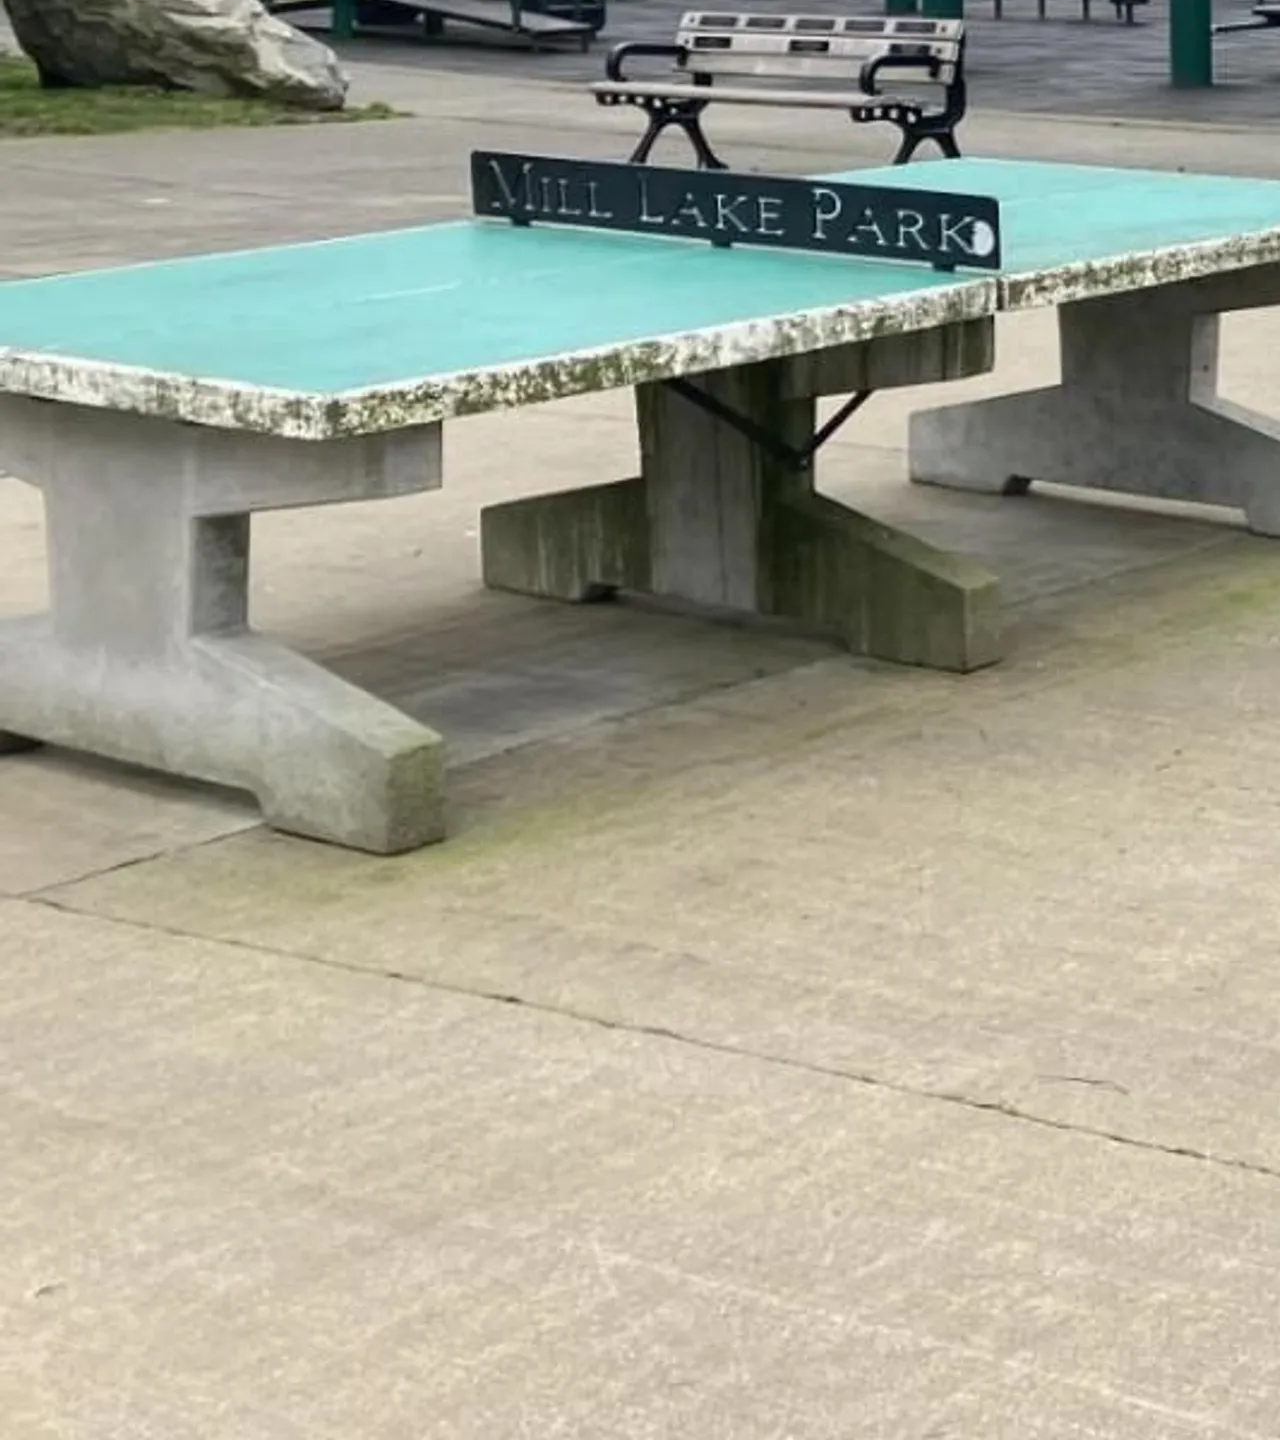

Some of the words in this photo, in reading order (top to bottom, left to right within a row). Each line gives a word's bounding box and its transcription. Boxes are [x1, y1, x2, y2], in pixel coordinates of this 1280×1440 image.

[488, 159, 613, 220] MILL
[639, 176, 785, 237] LAKE
[811, 188, 976, 253] PARK
